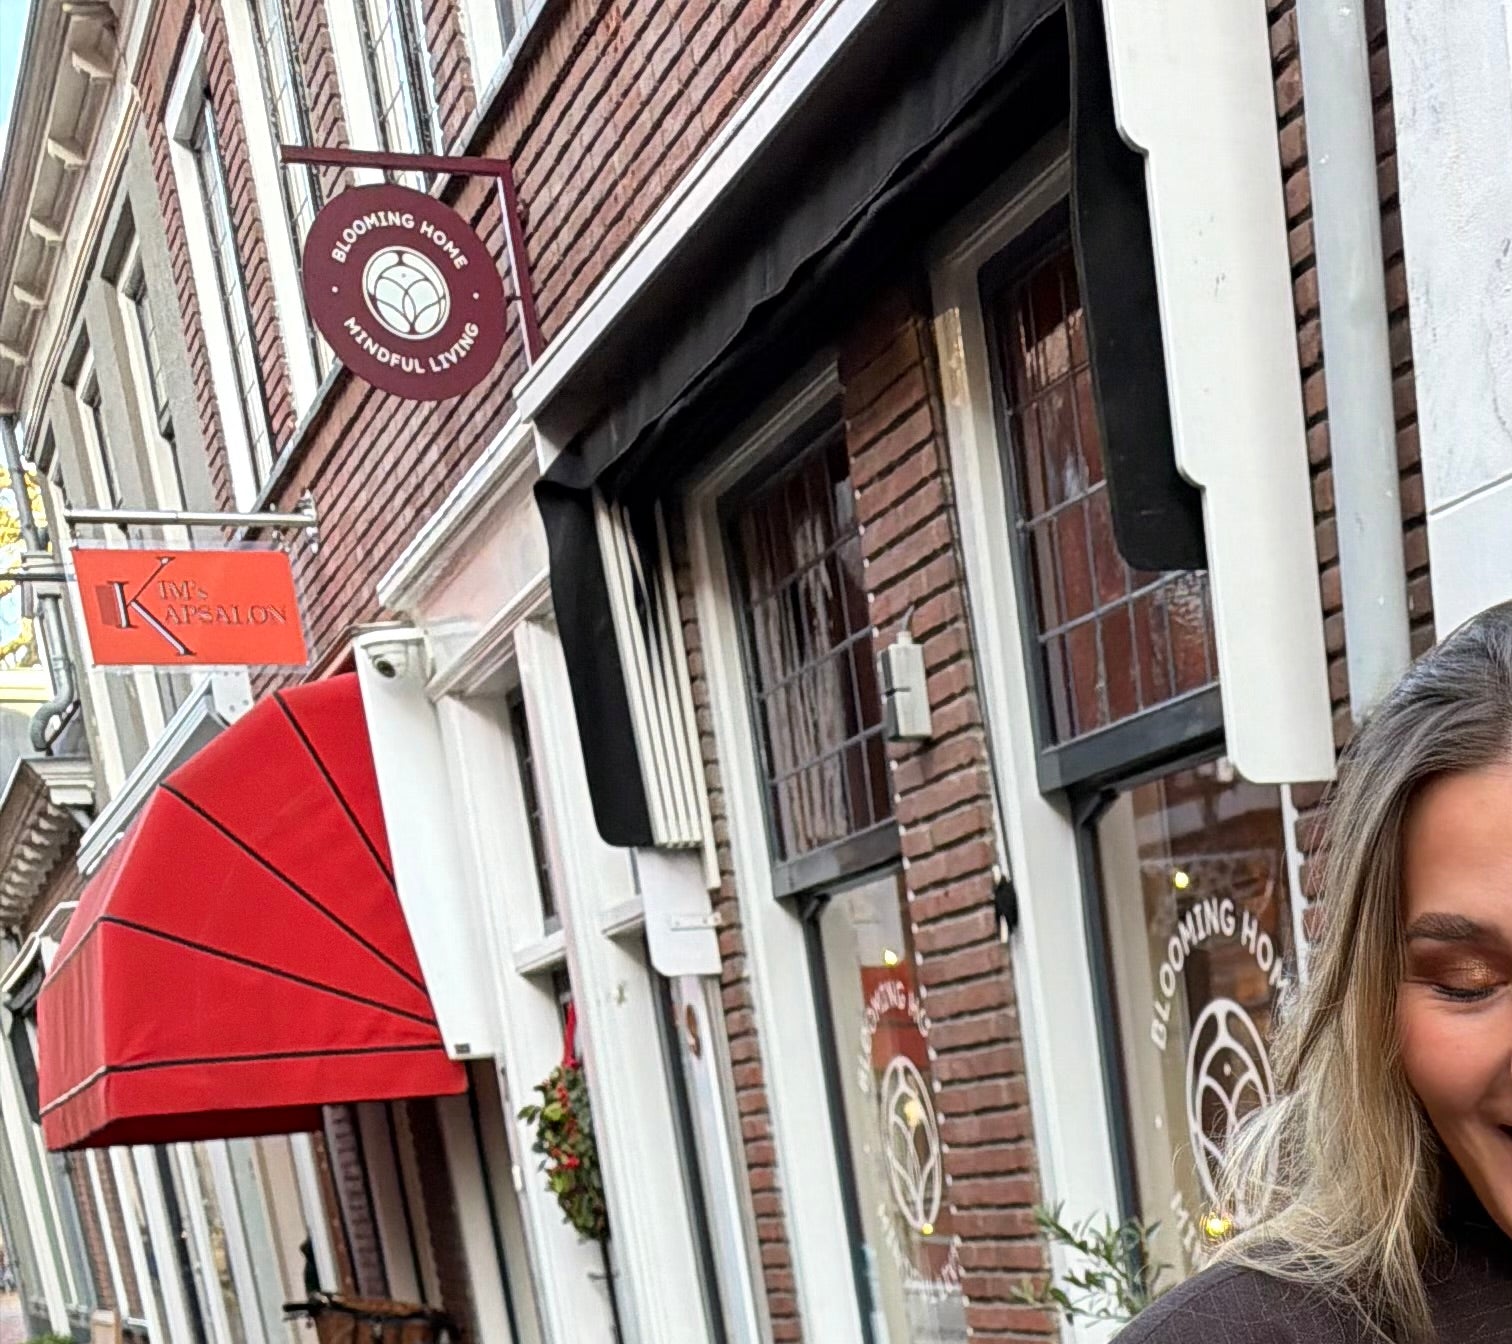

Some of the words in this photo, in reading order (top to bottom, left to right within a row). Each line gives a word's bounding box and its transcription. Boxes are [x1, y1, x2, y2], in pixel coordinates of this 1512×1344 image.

[331, 210, 416, 264] BLOOMING
[419, 220, 469, 270] HOME
[343, 316, 426, 374] MINDFUL
[428, 322, 479, 373] LIVING
[1151, 896, 1236, 1051] BLOOMING
[1241, 910, 1292, 989] HOM
